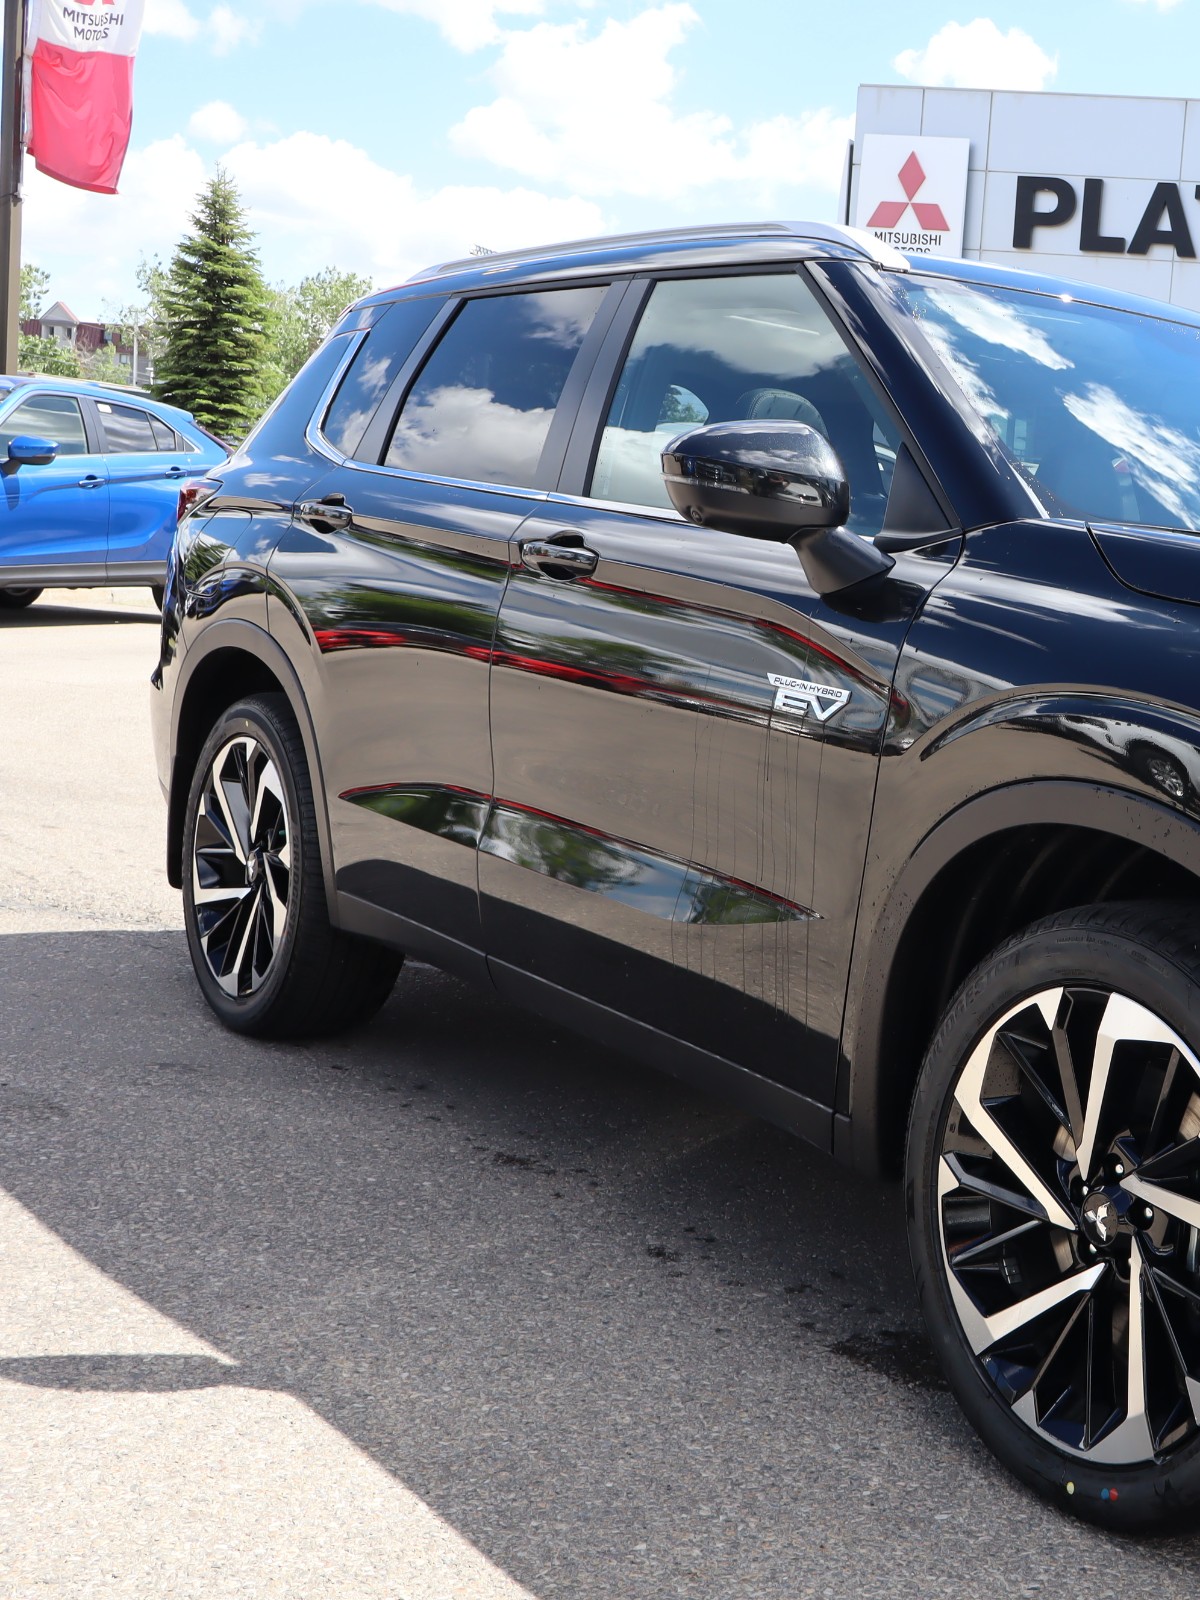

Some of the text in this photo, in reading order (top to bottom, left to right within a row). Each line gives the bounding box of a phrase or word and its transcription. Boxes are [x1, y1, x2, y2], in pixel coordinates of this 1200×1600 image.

[63, 7, 124, 26] MITSUBSHI
[73, 26, 110, 41] MOTOS
[874, 231, 942, 246] MITSUBISHI
[773, 676, 843, 698] PLUG-IN HYBRID
[774, 689, 850, 721] EV
